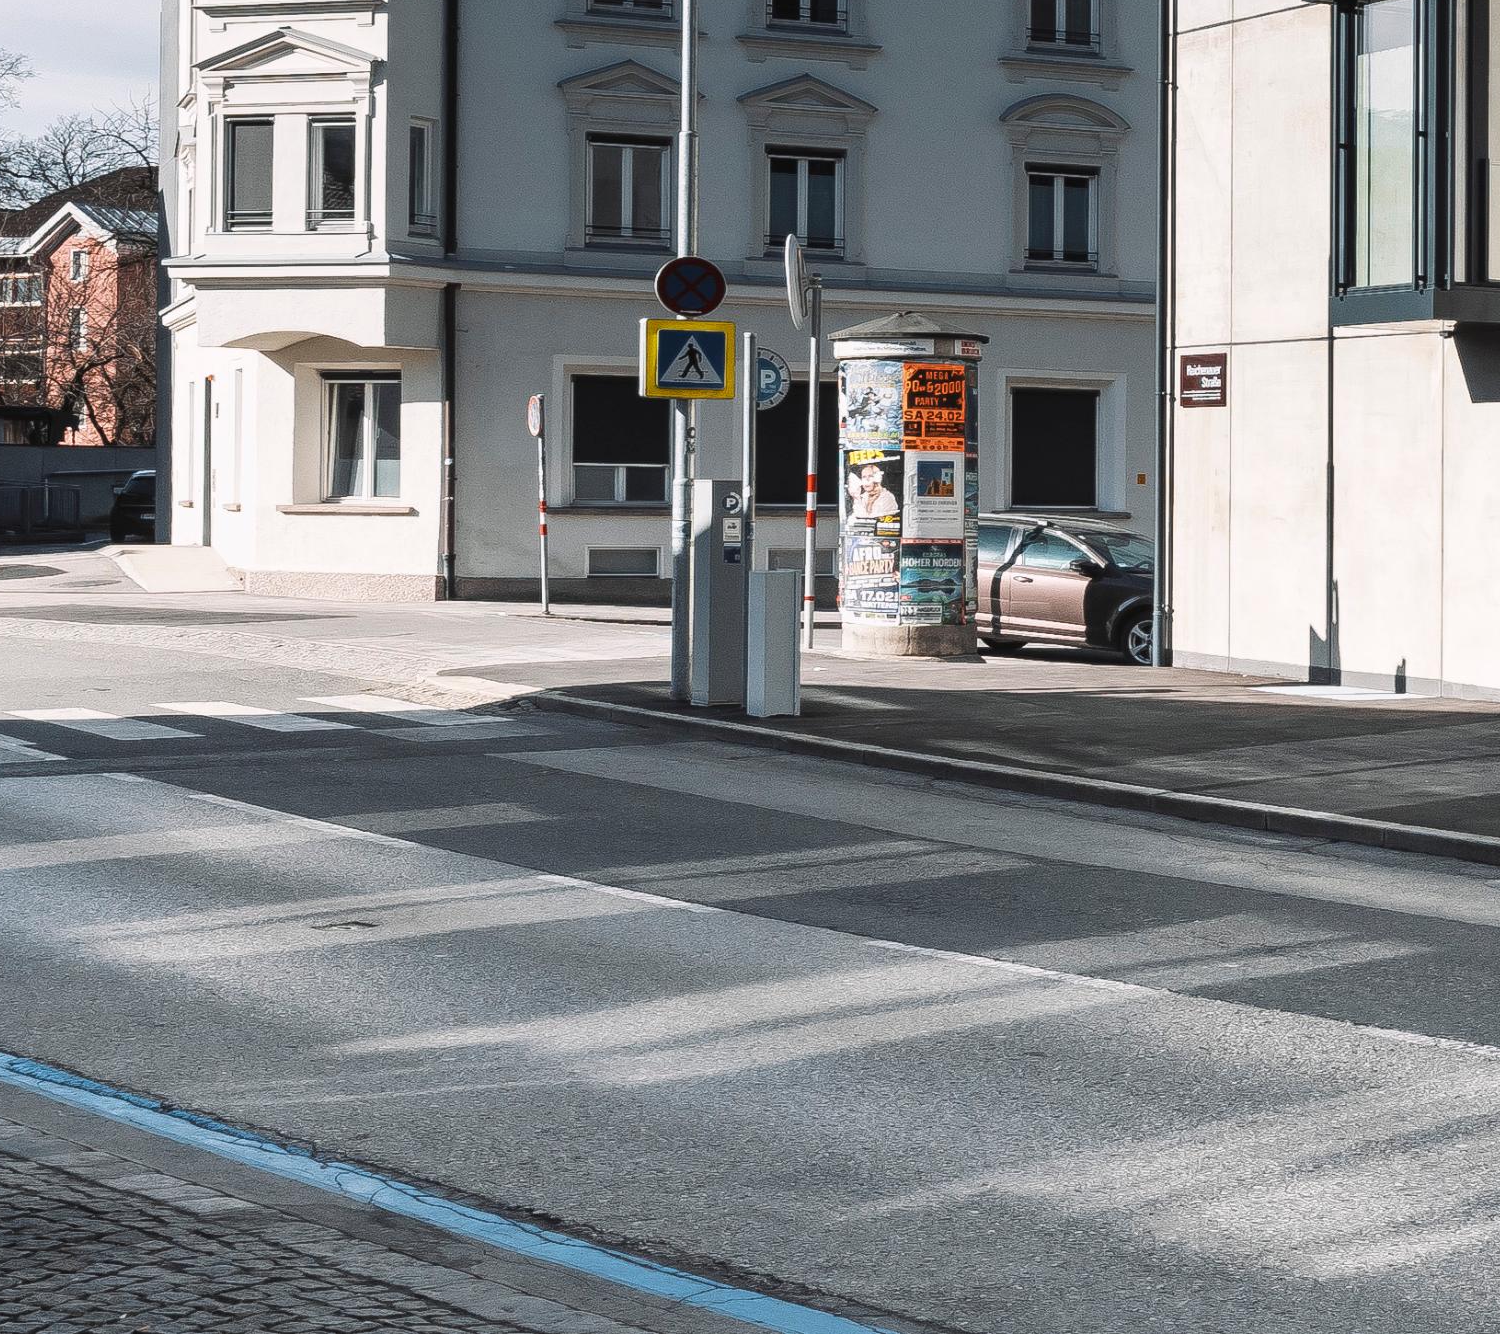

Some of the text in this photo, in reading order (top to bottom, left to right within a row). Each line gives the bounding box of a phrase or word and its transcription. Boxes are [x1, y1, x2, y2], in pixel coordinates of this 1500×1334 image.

[925, 371, 949, 380] MEGA
[1186, 364, 1222, 376] Reichenauer
[760, 369, 776, 388] P
[1201, 376, 1222, 388] Straße
[914, 397, 939, 406] PARTY
[904, 410, 924, 421] SA
[726, 497, 737, 508] P
[902, 557, 962, 567] HOHER NORDEN
